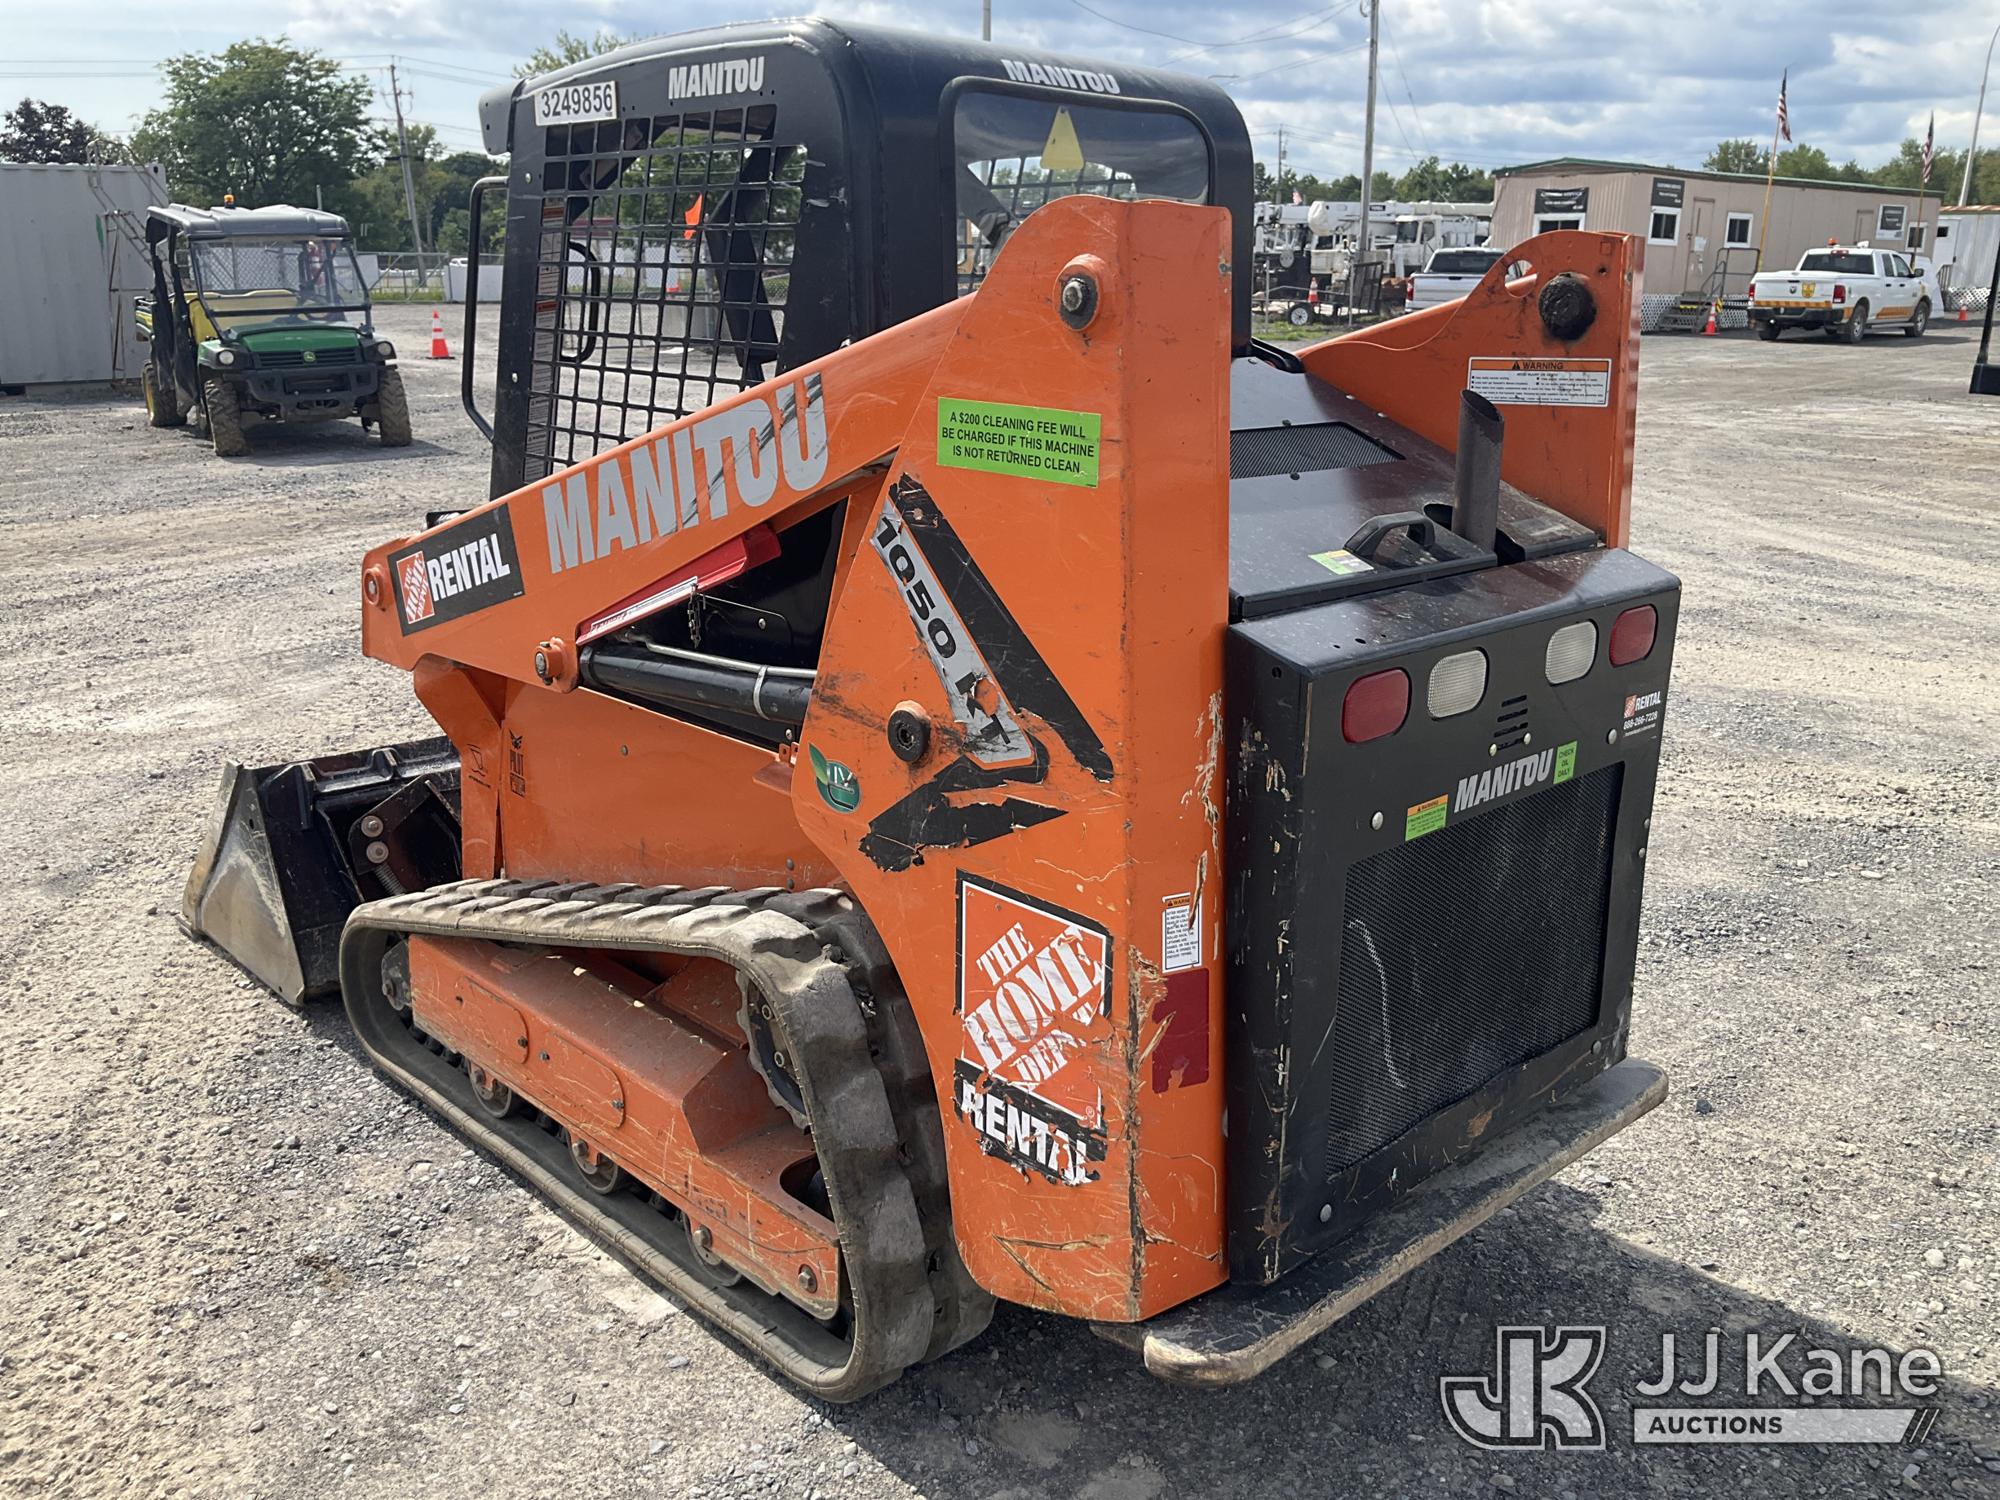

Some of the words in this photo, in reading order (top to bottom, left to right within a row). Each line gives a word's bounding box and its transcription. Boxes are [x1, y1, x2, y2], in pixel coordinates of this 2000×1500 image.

[668, 56, 765, 100] MANITOU
[1000, 59, 1120, 94] MANITOU
[541, 84, 613, 118] 3249856
[1522, 362, 1564, 370] WARNING
[942, 427, 954, 439] BE
[957, 429, 1005, 445] CHARGED
[1008, 435, 1017, 447] IF
[1020, 436, 1042, 450] THIS
[1045, 440, 1095, 457] MACHINE
[950, 412, 957, 423] A
[959, 412, 980, 425] $200
[982, 415, 1034, 432] CLEANING
[1037, 421, 1057, 435] FEE
[1060, 424, 1086, 438] WILL
[542, 372, 828, 574] MANITOU
[953, 445, 961, 457] IS
[964, 446, 984, 460] NOT
[986, 448, 1041, 467] RETURNED
[1044, 457, 1080, 474] CLEAN
[426, 533, 511, 602] RENTAL
[876, 516, 957, 659] 1050
[1635, 690, 1661, 711] RENTAL
[1558, 748, 1575, 761] CHECK
[1454, 748, 1554, 814] MANITOU
[976, 922, 1034, 986] THE
[964, 924, 1103, 1074] HOME
